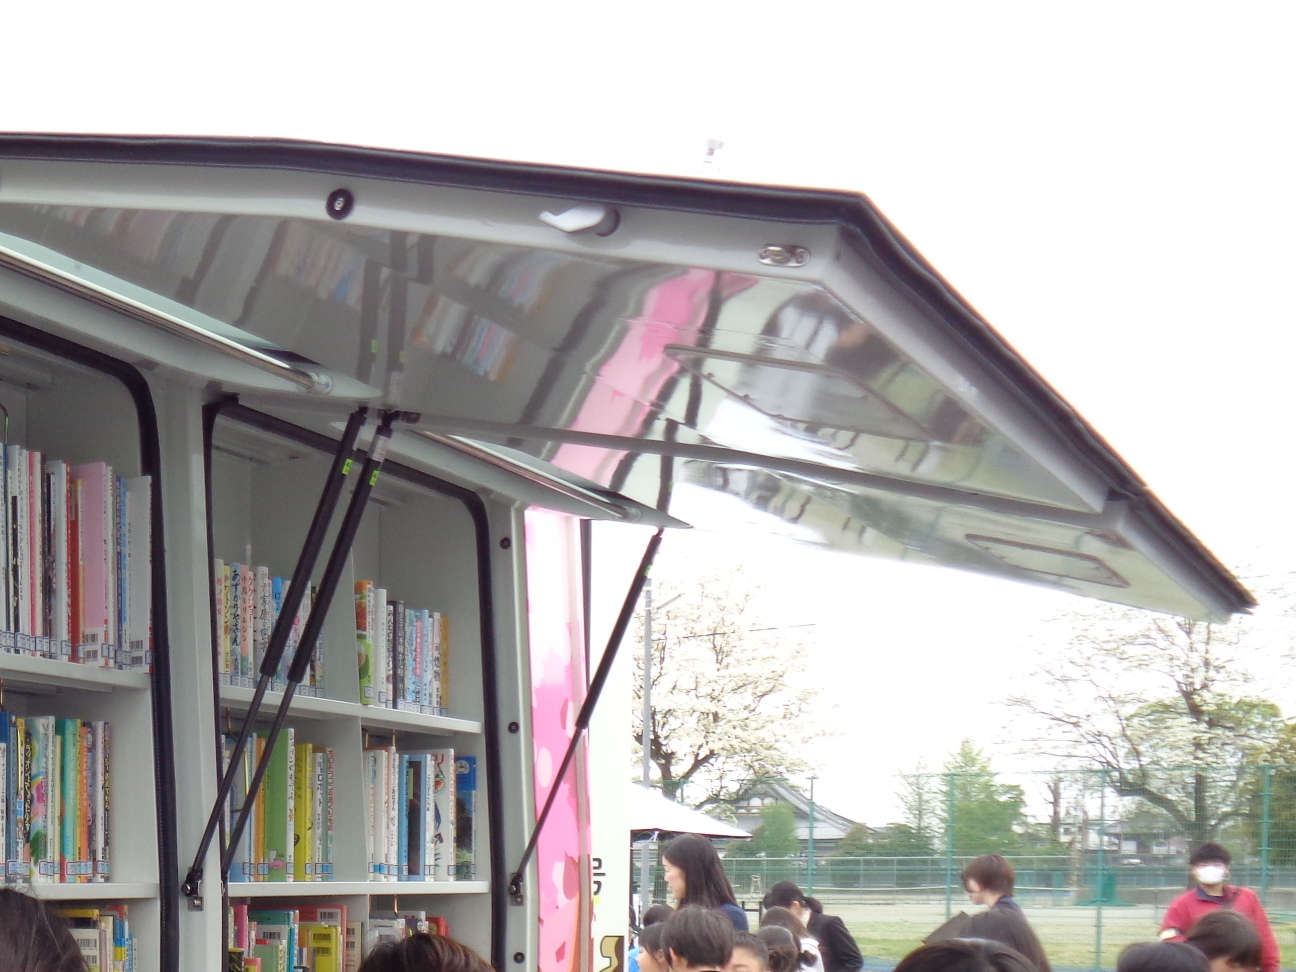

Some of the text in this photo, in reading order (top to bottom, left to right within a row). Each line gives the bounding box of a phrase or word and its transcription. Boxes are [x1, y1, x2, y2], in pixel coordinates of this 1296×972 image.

[231, 567, 241, 647] あずかりやさん
